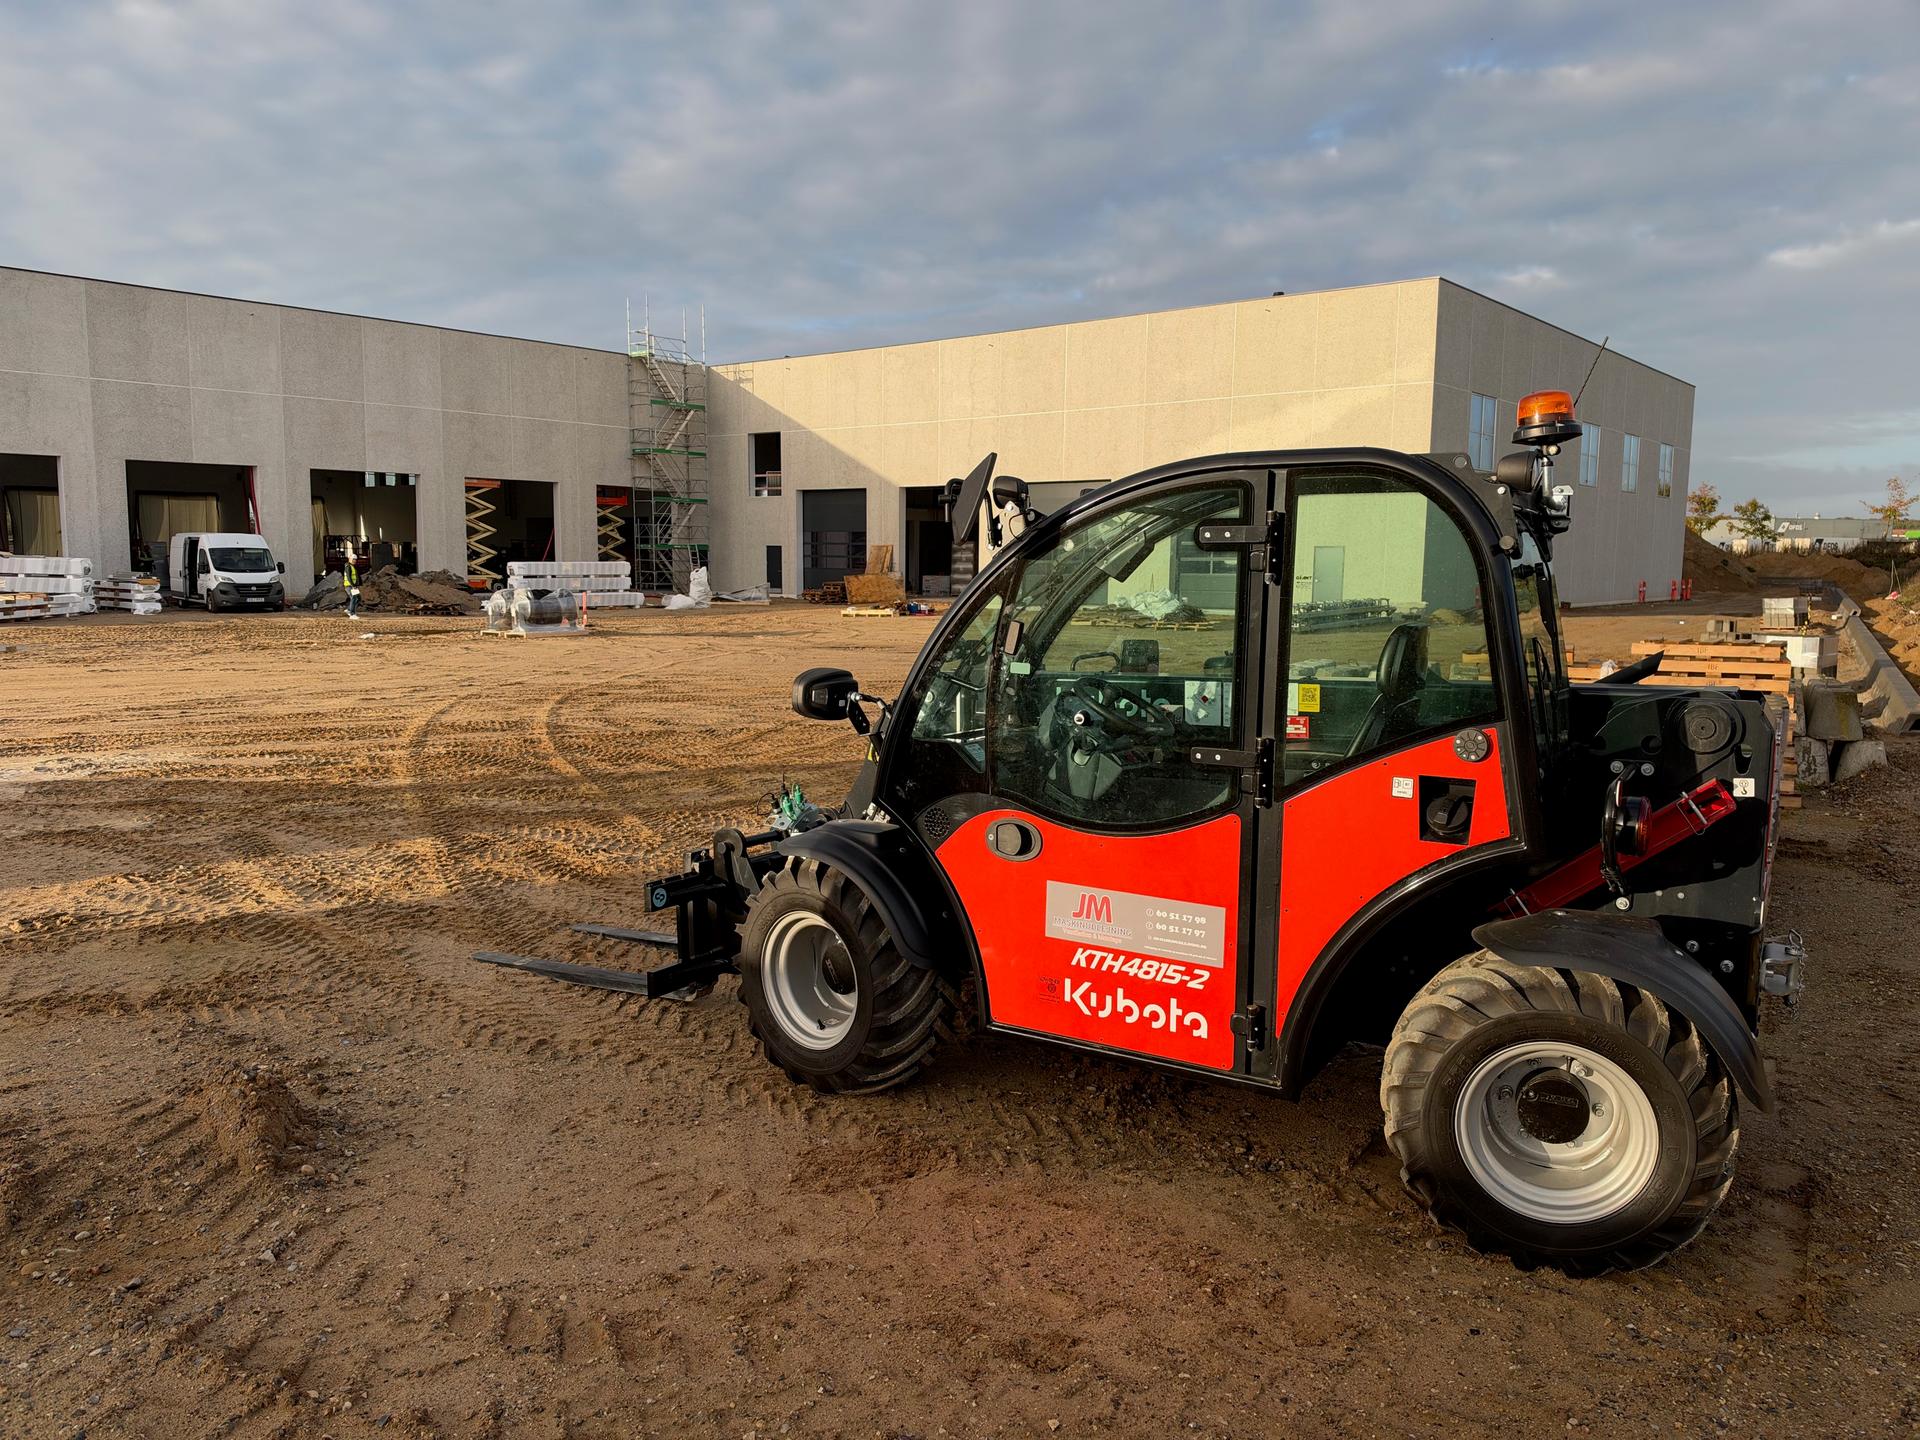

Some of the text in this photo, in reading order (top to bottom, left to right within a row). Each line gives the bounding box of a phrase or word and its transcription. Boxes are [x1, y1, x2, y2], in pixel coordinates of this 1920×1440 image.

[1072, 892, 1113, 924] JM
[1156, 909, 1207, 925] 60 51 17 98
[1156, 922, 1206, 938] 60 51 17 97
[1071, 947, 1211, 991] KTH4815-2
[1064, 977, 1209, 1040] Kubota
